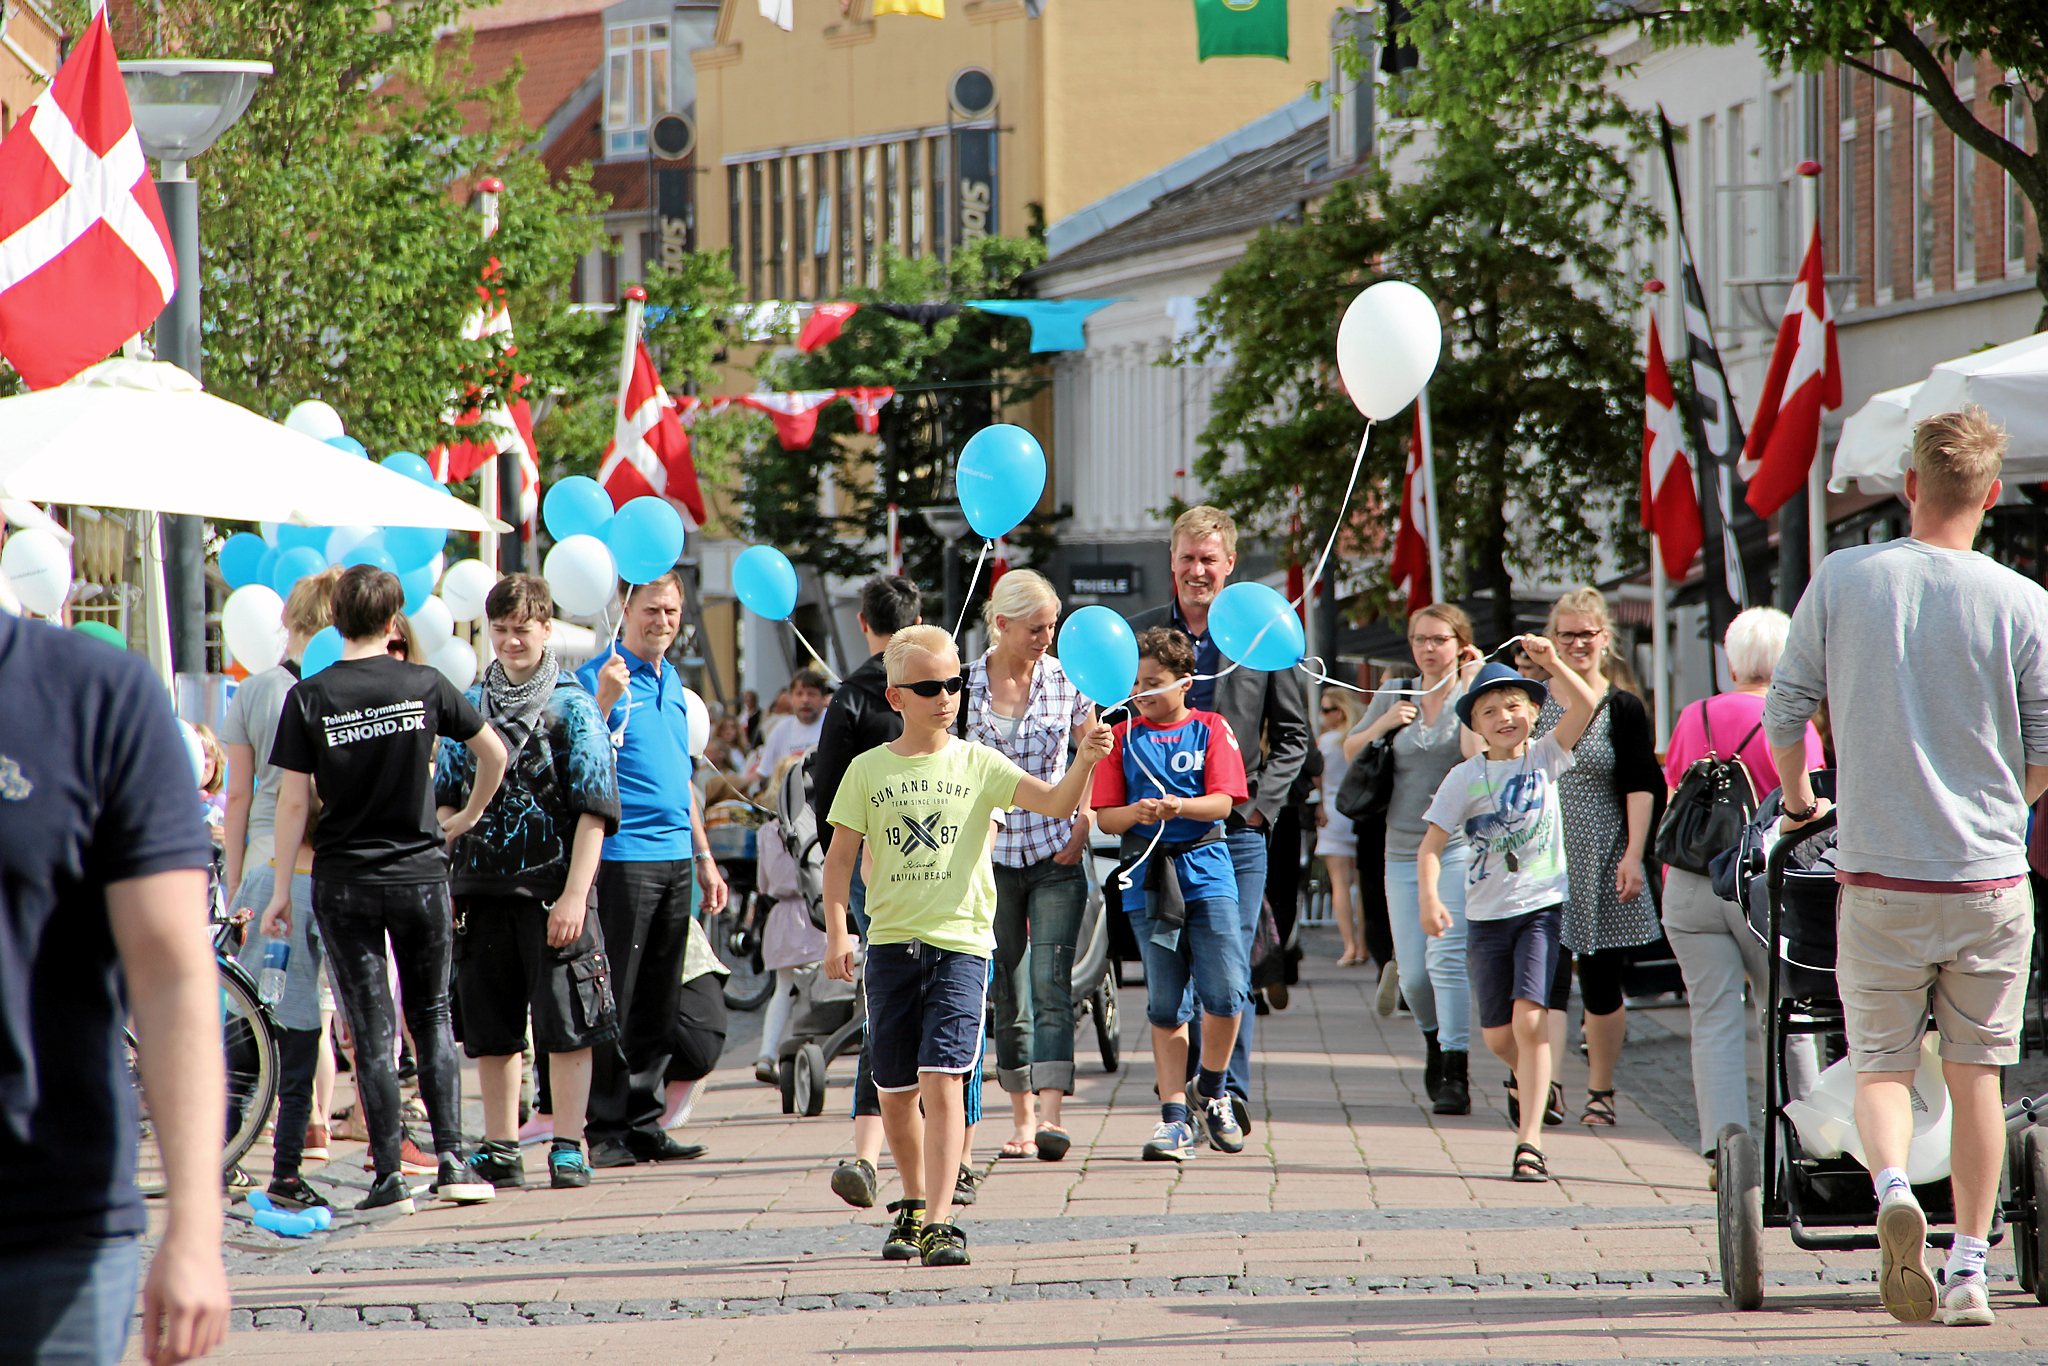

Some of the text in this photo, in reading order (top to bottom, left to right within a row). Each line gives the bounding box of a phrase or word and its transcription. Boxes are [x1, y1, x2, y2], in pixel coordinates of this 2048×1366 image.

[1072, 579, 1129, 593] THIELE
[322, 699, 424, 726] Teknisk Gymnasium
[326, 714, 426, 747] ESNORD.DK
[870, 780, 971, 808] SUN AND SURF
[911, 798, 930, 806] SINCE
[885, 825, 958, 846] 19 87
[924, 870, 952, 881] BEACH
